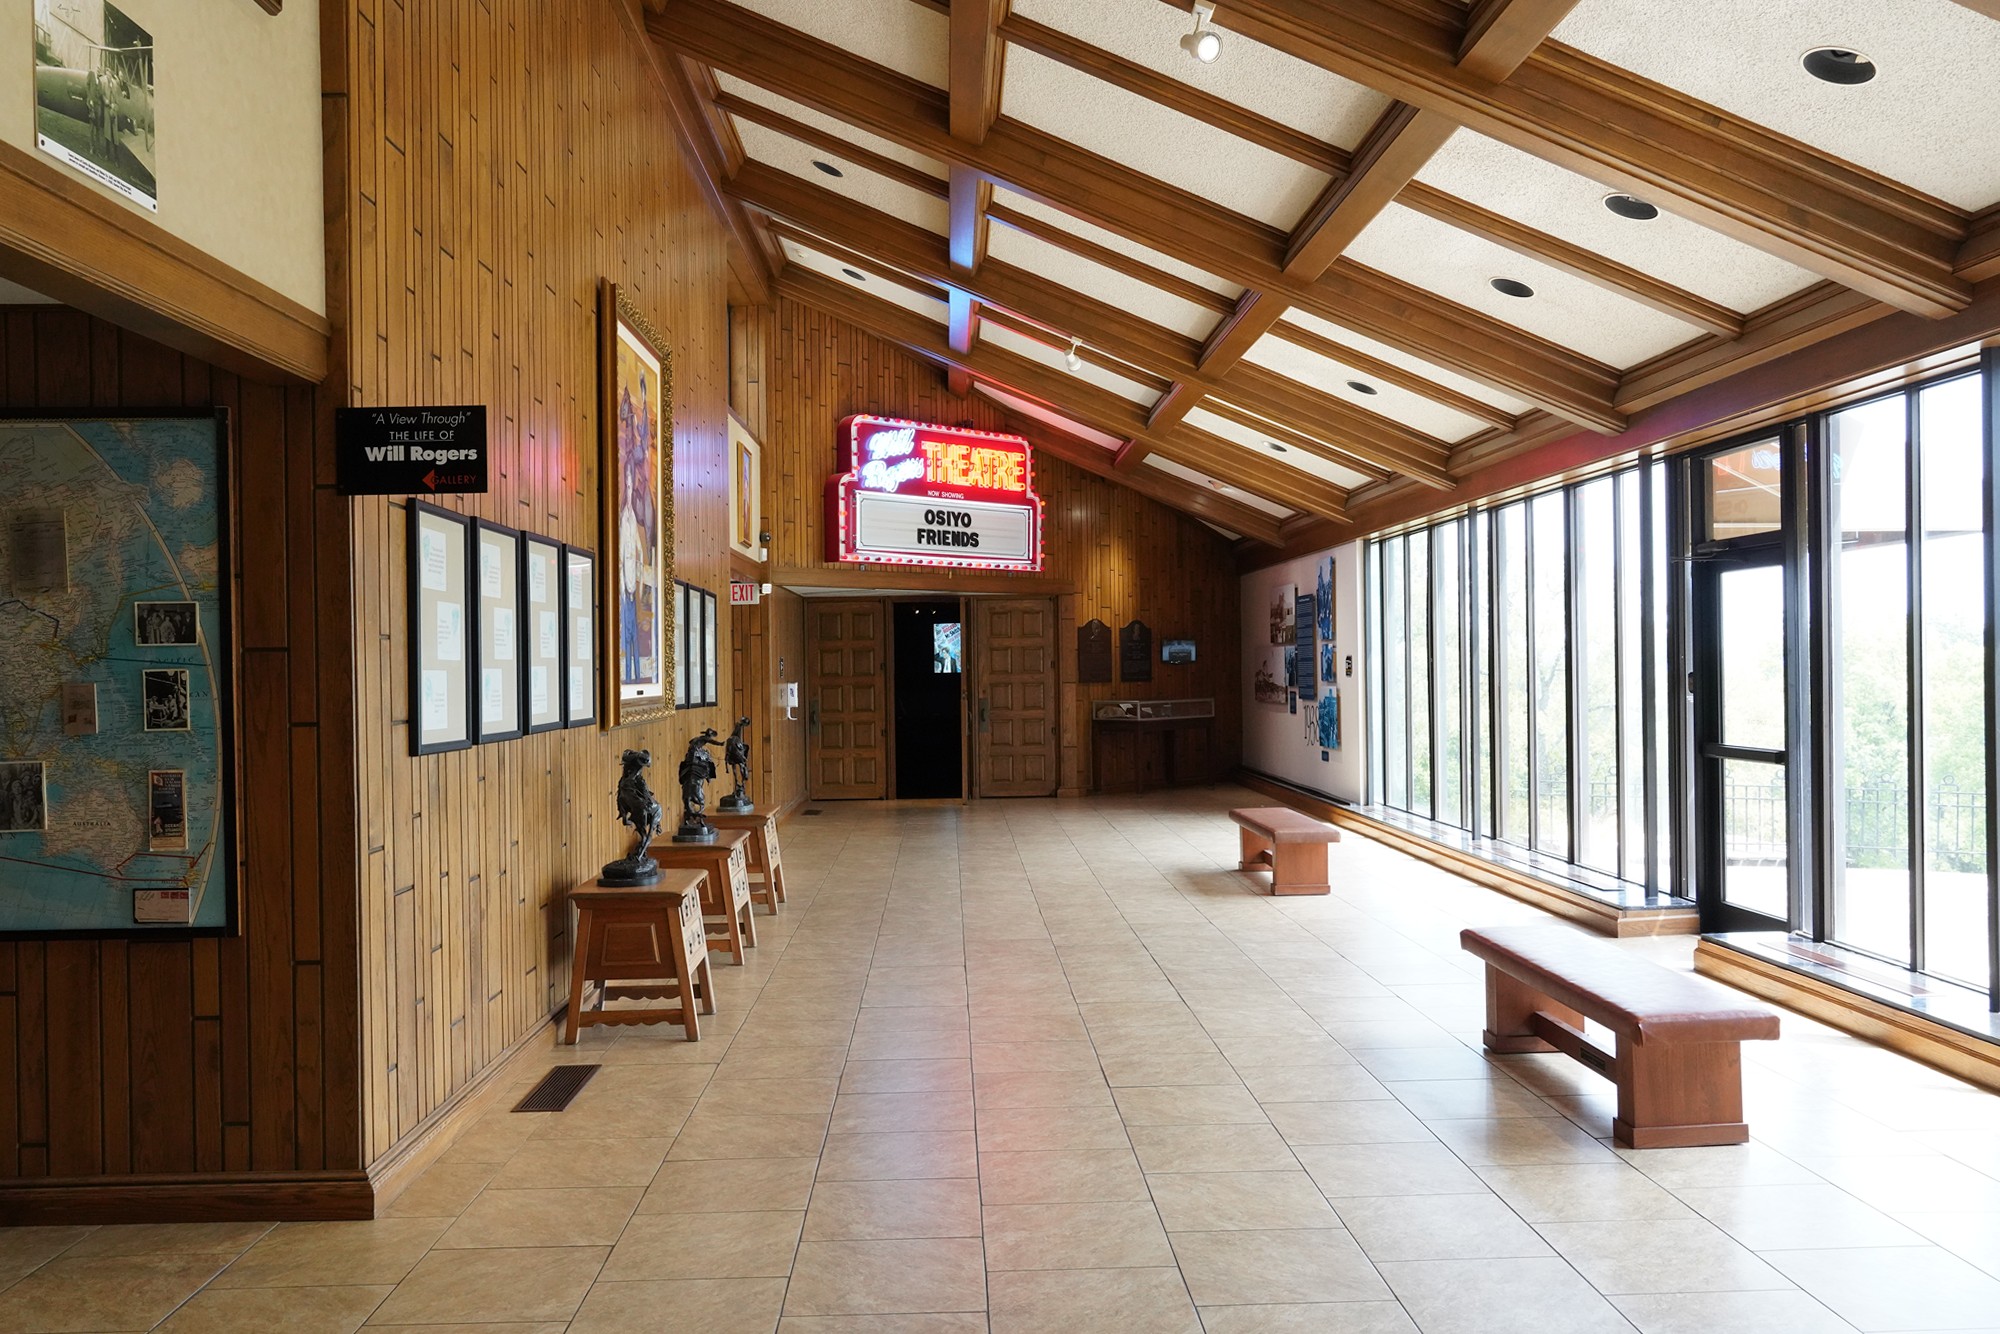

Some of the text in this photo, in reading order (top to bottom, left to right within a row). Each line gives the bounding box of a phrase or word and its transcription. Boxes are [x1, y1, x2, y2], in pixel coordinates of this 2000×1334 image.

[389, 412, 417, 425] View
[389, 429, 455, 441] THE LIFE OF
[364, 445, 478, 465] Will Rogers
[921, 440, 1026, 492] THEATRE
[431, 474, 477, 485] GALLERY
[941, 491, 964, 500] SHOWING
[924, 509, 972, 528] OSIYO
[916, 528, 979, 548] FRIENDS
[731, 584, 754, 602] EXIT
